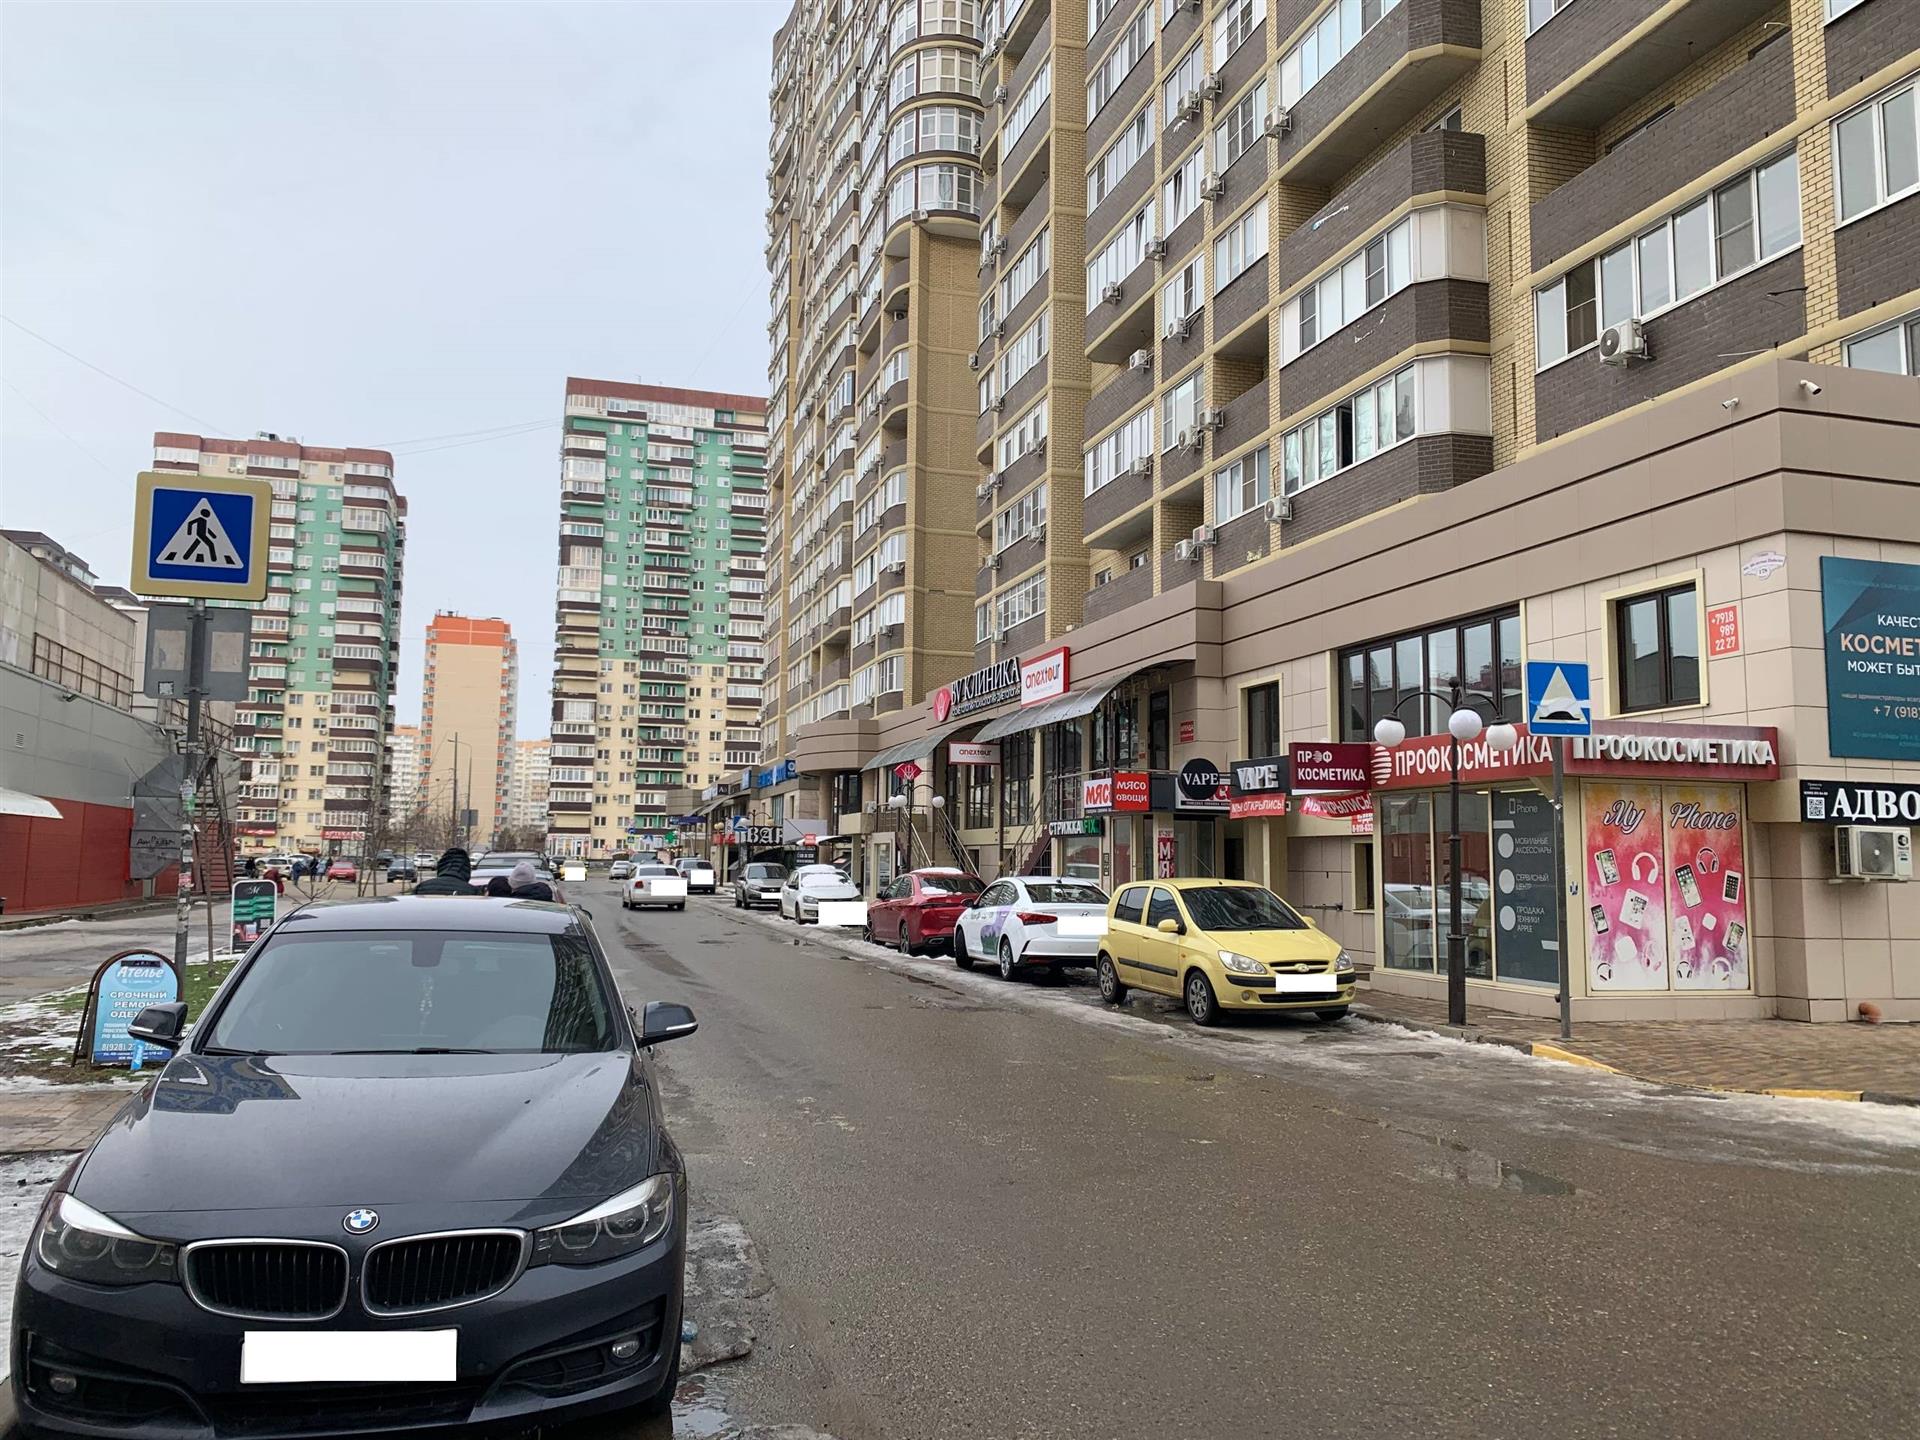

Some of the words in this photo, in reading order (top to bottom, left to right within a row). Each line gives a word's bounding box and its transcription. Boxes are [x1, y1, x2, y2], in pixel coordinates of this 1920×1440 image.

[1720, 623, 1735, 638] 989
[1847, 660, 1893, 674] МОЖЕТ
[963, 656, 1021, 701] КЛИНИКА
[1025, 663, 1060, 689] anextour
[1573, 733, 1777, 766] ПРОФКОСМЕТИКА
[1182, 772, 1219, 786] VAPE
[1236, 764, 1279, 790] VAPE
[1297, 768, 1366, 781] КОСМЕТИКА
[1116, 780, 1146, 790] МЯСО
[1116, 793, 1148, 803] ОВОЩИ
[1830, 787, 1920, 822] АДВО
[1603, 800, 1646, 834] My
[1670, 802, 1738, 830] Phone
[1048, 820, 1083, 836] СТРИЖКА
[117, 966, 165, 978] Ателье
[110, 991, 167, 999] СРОЧНЫЙ
